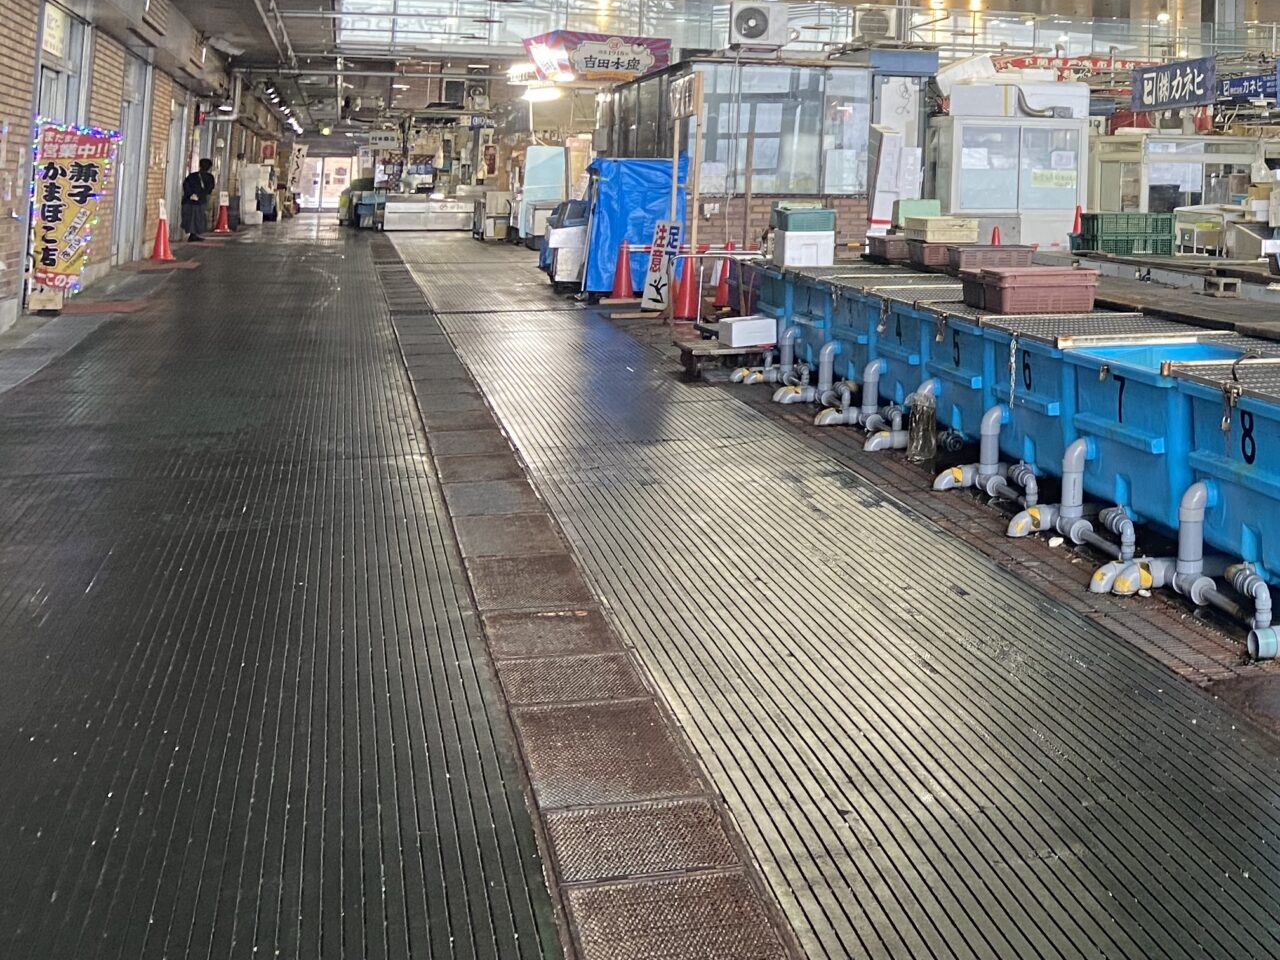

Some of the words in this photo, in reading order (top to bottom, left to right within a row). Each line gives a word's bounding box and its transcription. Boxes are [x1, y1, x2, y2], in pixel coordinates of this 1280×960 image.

[583, 54, 641, 71] 吉田水産
[1243, 78, 1263, 94] カネヒ
[43, 142, 108, 159] 営業中!!
[649, 224, 668, 273] 注意
[952, 329, 961, 367] 5
[1022, 349, 1032, 390] 6
[1113, 374, 1126, 424] 7
[1240, 409, 1256, 465] 8
